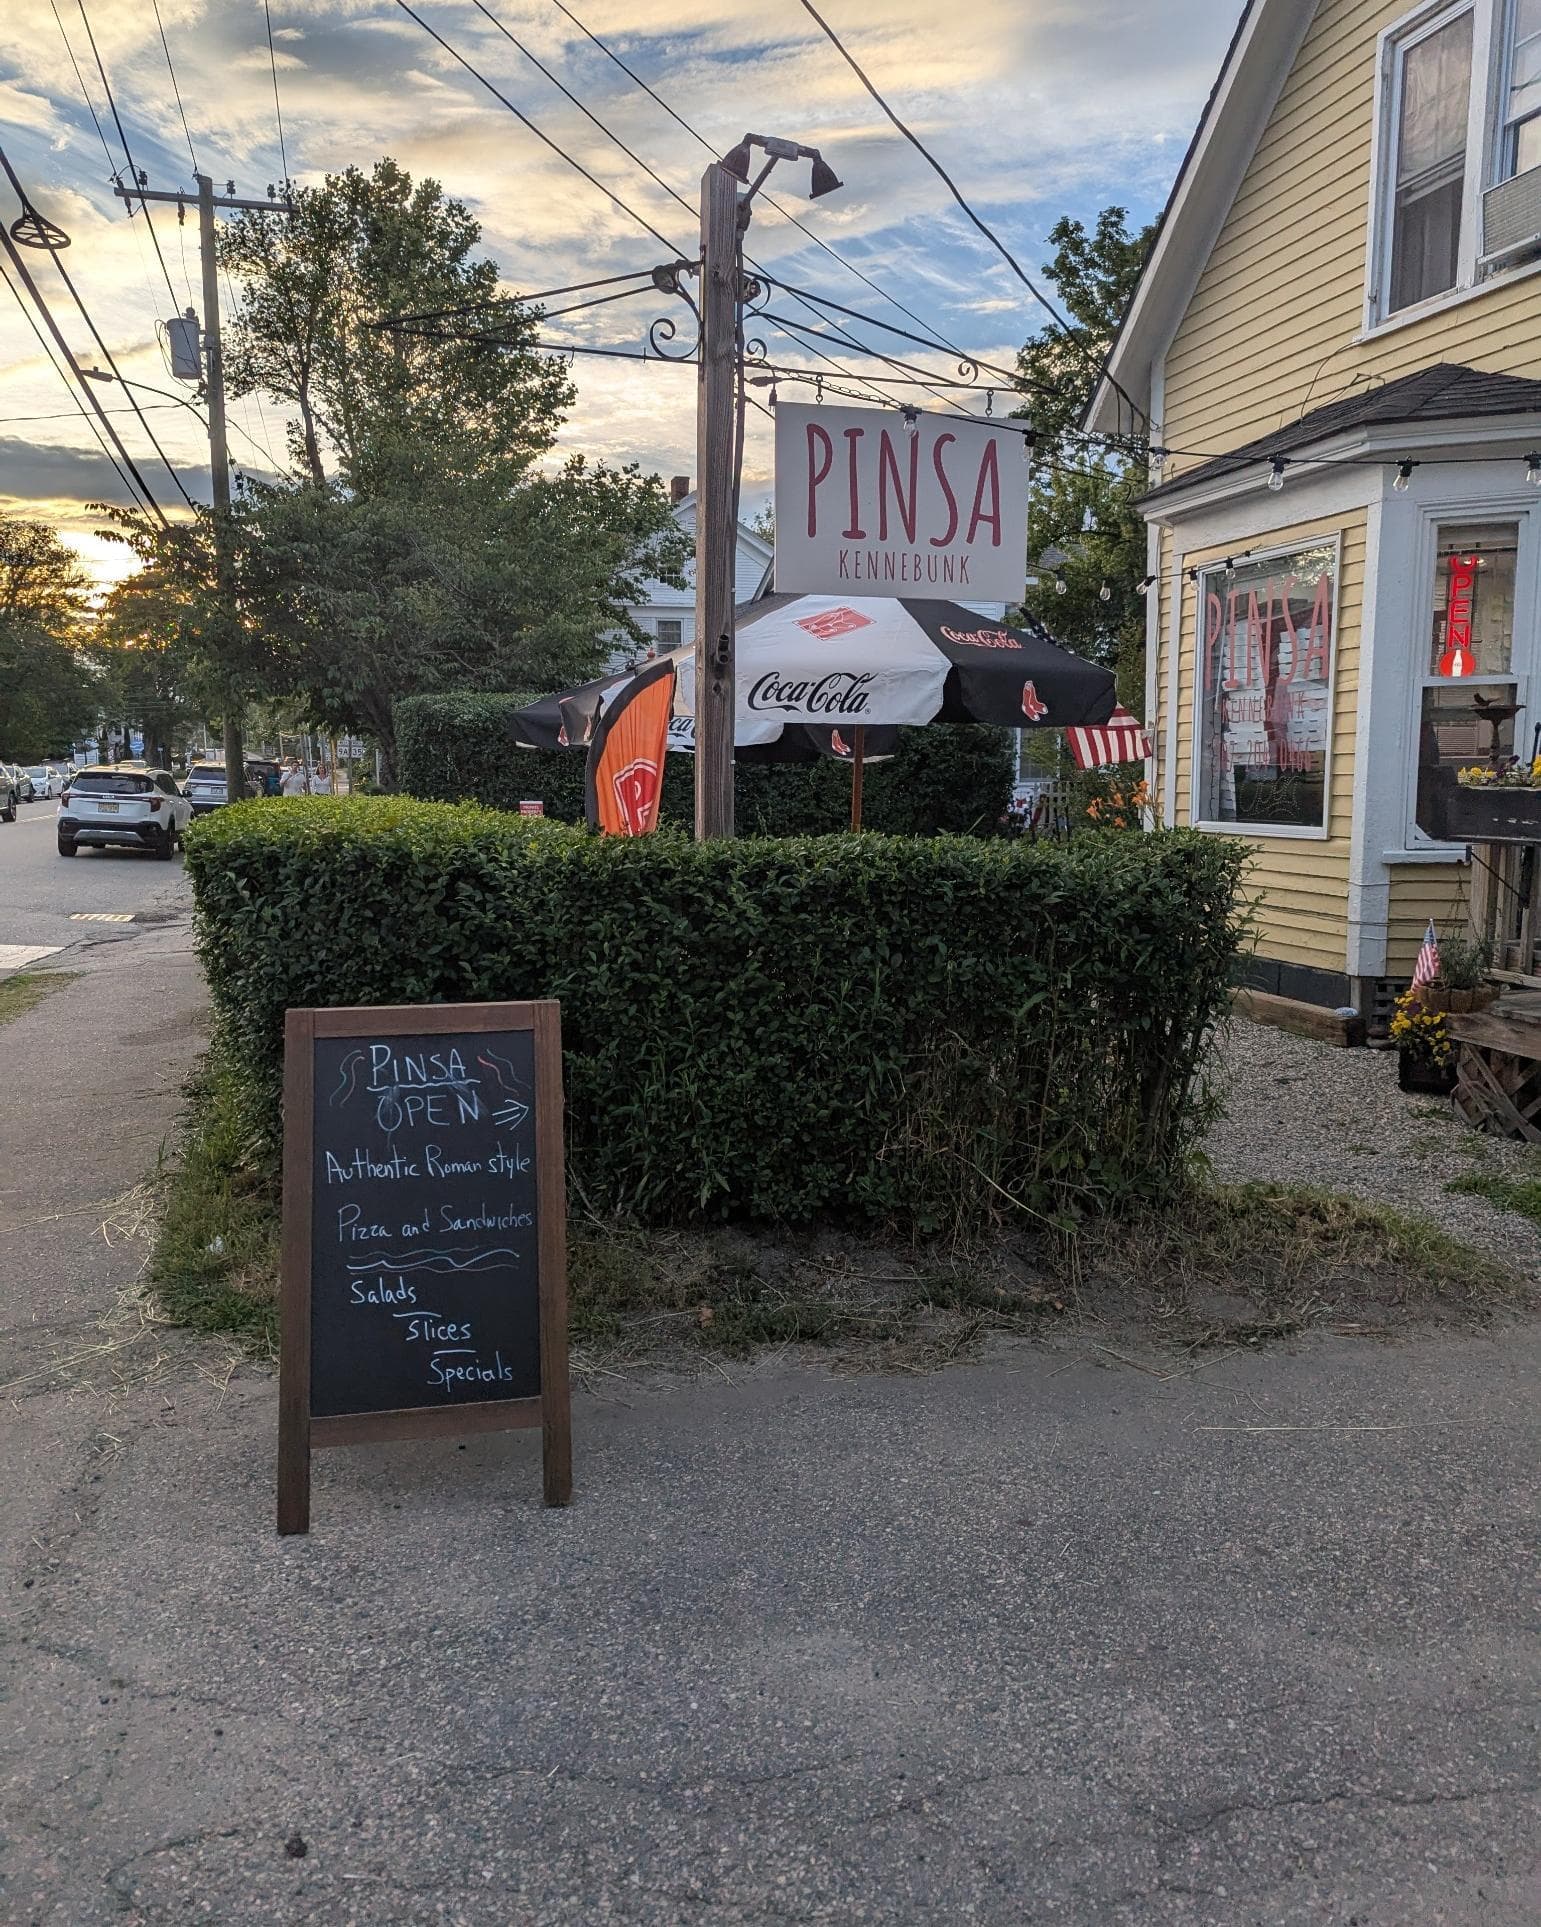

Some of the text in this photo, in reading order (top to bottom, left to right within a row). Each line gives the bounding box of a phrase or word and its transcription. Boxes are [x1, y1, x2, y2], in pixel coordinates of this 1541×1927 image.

[806, 423, 1001, 547] PINSA
[838, 549, 970, 585] KENNEBUNK
[1448, 554, 1479, 649] OPEN
[940, 625, 1025, 650] Coca-Cola
[1205, 570, 1330, 691] PINSA
[747, 671, 878, 715] Coca-Cola
[1221, 691, 1305, 724] KENNEBNK
[369, 1044, 467, 1086] PINSA
[377, 1089, 479, 1132] OPEN
[325, 1140, 531, 1184] Authentic Roman style
[337, 1202, 533, 1242] Pizza and Sandwiches
[350, 1275, 417, 1304] Salads
[426, 1350, 513, 1393] Specials
